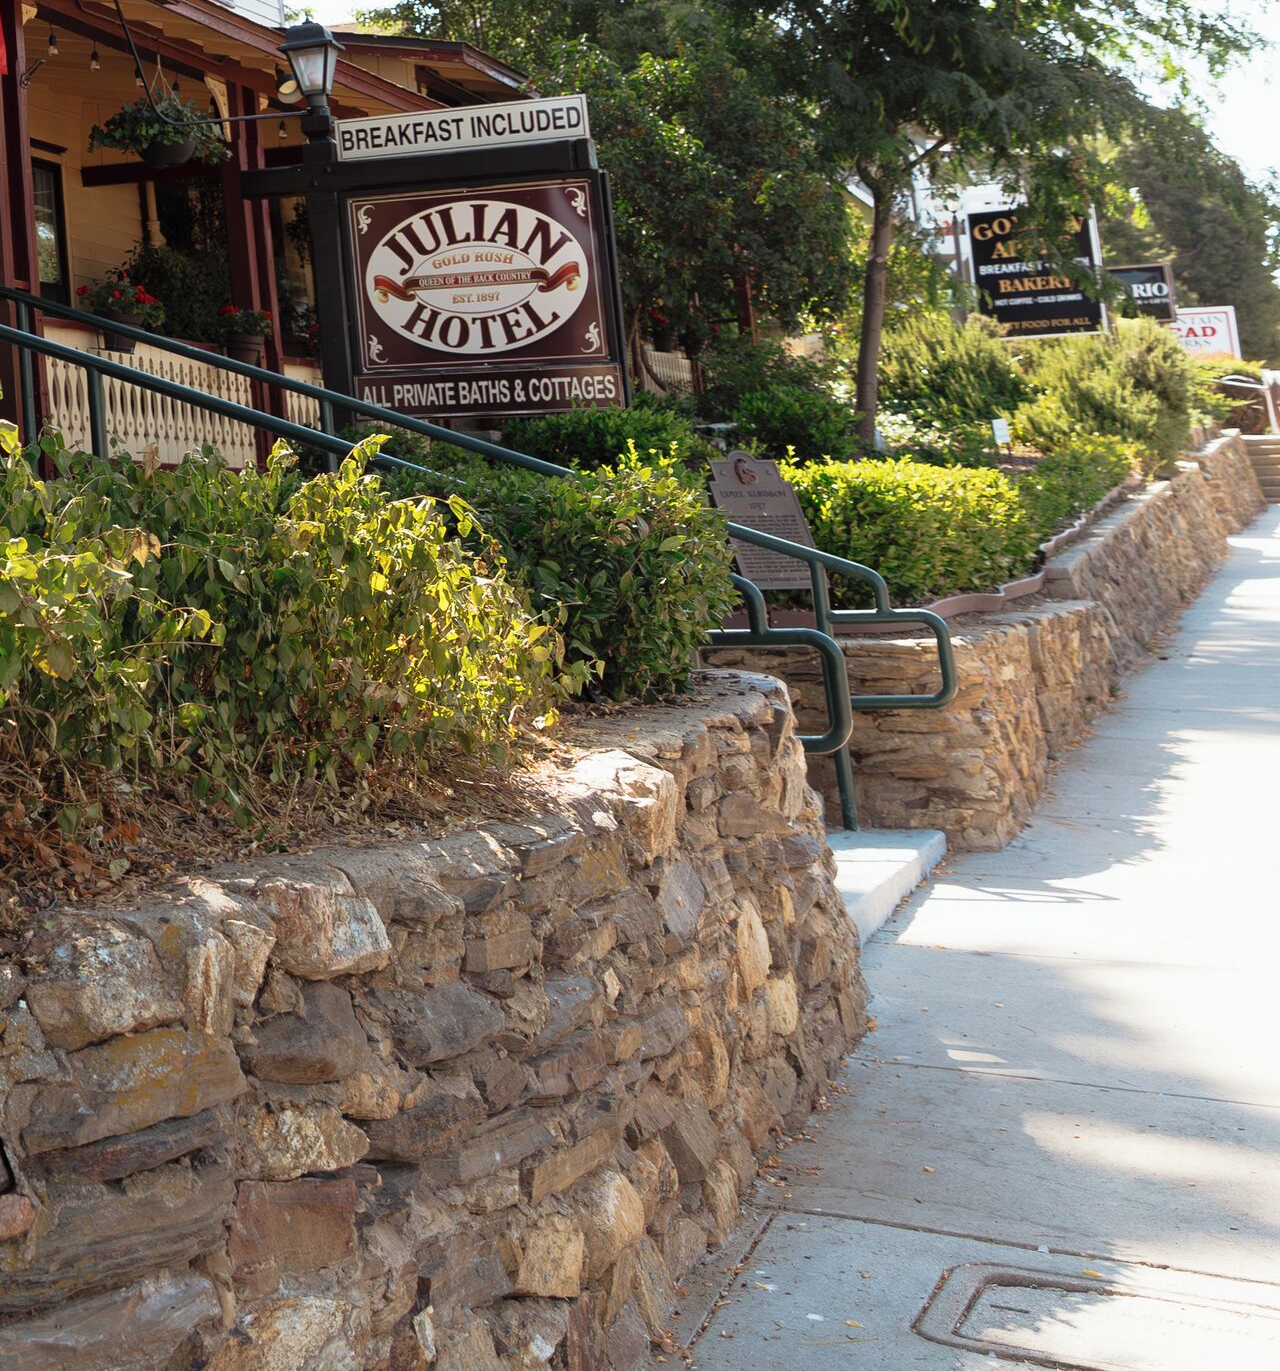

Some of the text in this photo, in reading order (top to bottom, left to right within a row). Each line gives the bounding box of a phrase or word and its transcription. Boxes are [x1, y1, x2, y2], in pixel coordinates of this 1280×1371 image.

[341, 106, 582, 152] BREAKFAST INCLUDED
[382, 203, 573, 275] JULIAN
[431, 251, 515, 269] GOLD RUSH
[979, 261, 1043, 276] BREAKFAST
[418, 271, 532, 288] QUEEN OF THE BACK COUNTRY
[997, 276, 1071, 293] BAKERY
[452, 292, 501, 304] EST. 1897
[1130, 282, 1169, 297] RIO
[400, 300, 560, 349] HOTEL
[1022, 319, 1050, 329] FOOD
[1072, 316, 1092, 326] ALL
[363, 375, 617, 408] ALL PRIVATE BATHS & COTTAGES
